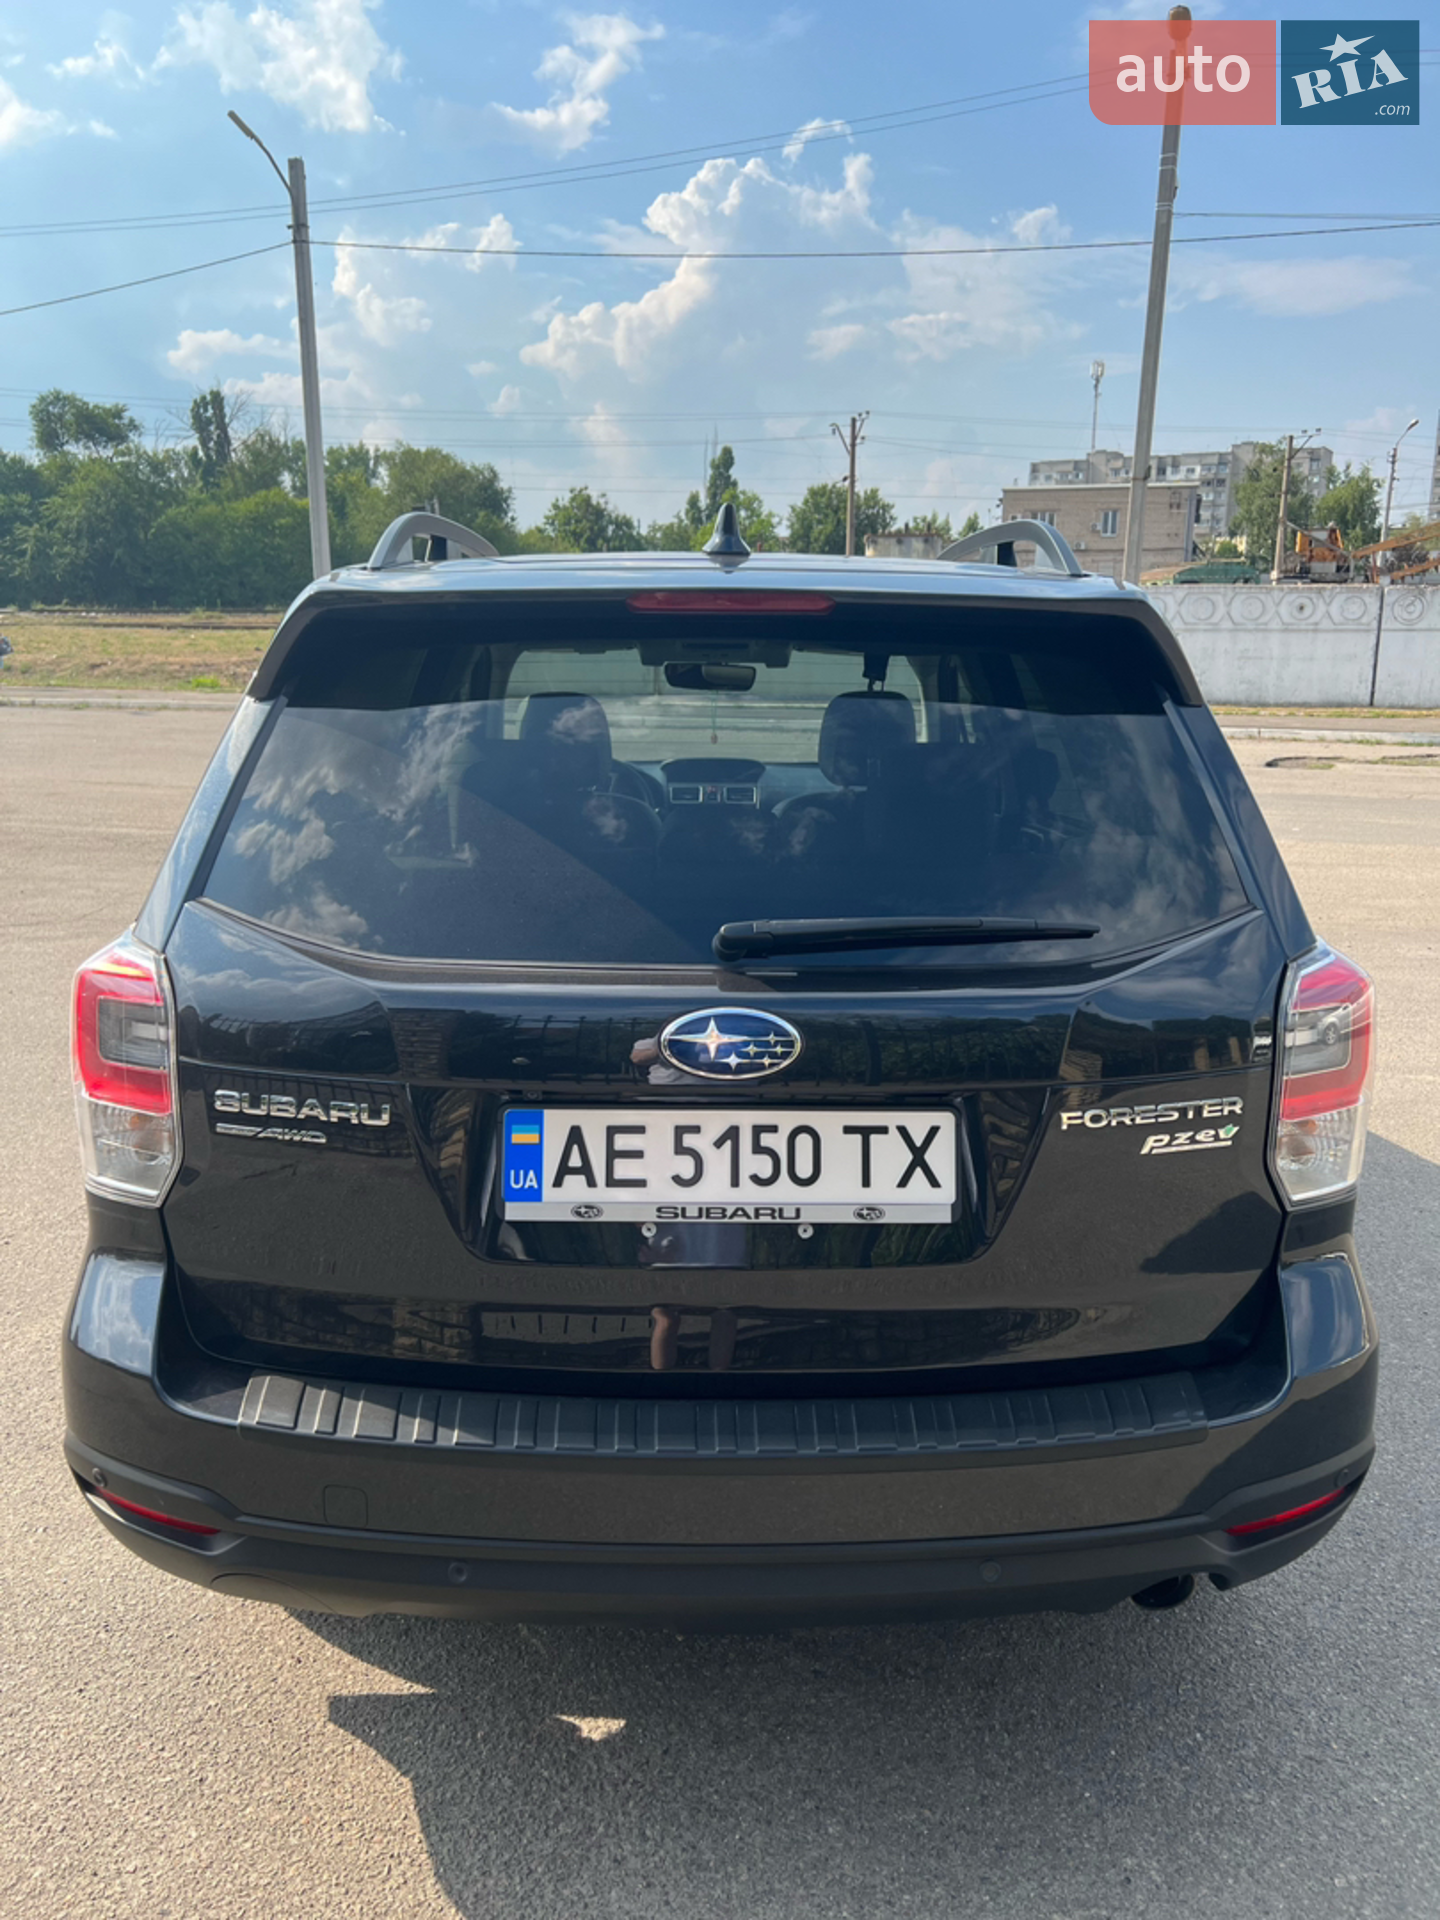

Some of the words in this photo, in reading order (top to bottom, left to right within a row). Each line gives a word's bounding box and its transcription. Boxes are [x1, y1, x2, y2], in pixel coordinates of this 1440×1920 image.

[214, 1089, 391, 1126] SUBARU
[1060, 1096, 1244, 1131] FORESTER
[258, 1127, 327, 1144] AWD
[552, 1125, 648, 1189] AE
[671, 1125, 822, 1188] 5150
[842, 1125, 942, 1189] TX
[509, 1169, 539, 1189] UA
[655, 1206, 802, 1221] SUBARU
